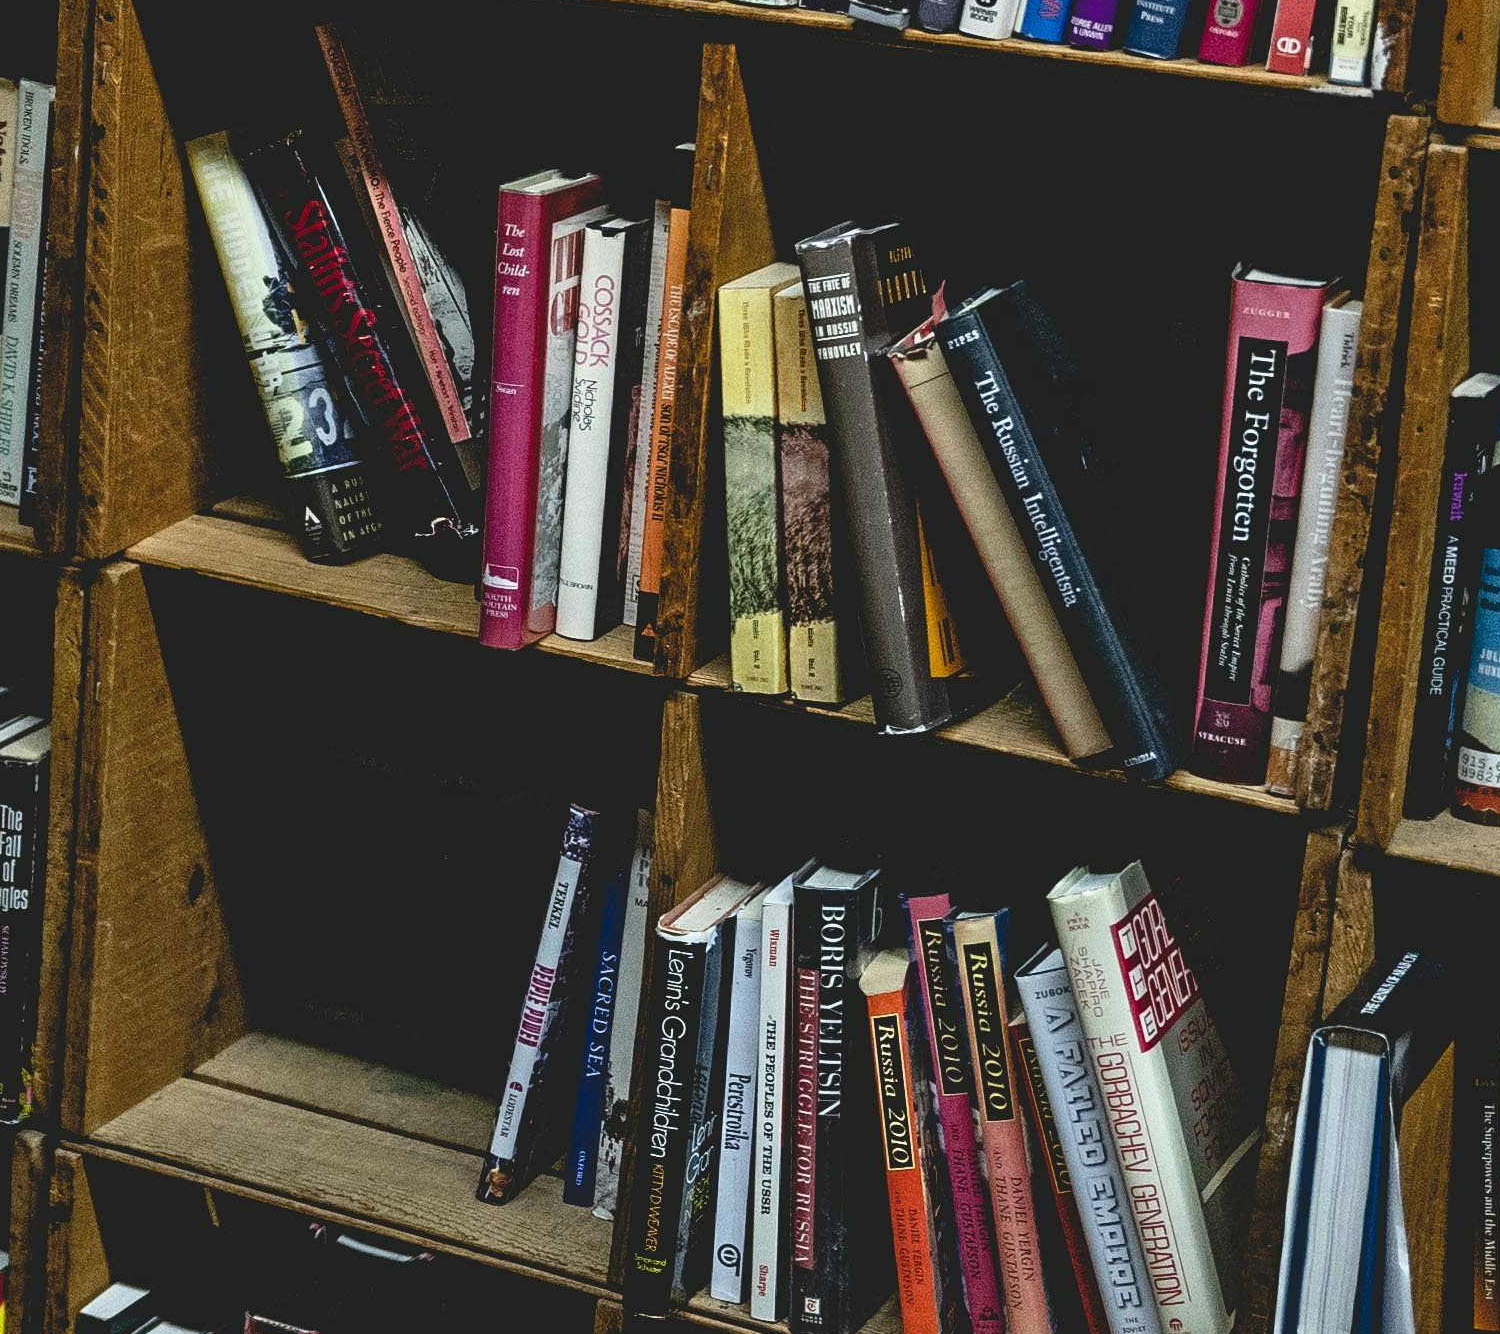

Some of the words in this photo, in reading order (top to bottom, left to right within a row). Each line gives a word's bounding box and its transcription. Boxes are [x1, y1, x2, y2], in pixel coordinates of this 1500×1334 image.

[503, 243, 526, 259] Lost
[504, 224, 526, 239] The
[498, 262, 531, 278] Child-
[502, 285, 522, 297] ren
[590, 273, 617, 368] COSSACK
[1248, 348, 1281, 402] The
[977, 370, 1001, 415] The
[992, 416, 1030, 490] Russian
[1022, 492, 1081, 608] Intelligentsia
[1232, 411, 1271, 541] Forgotten
[0, 804, 23, 832] The
[0, 832, 22, 858] Fall
[2, 861, 15, 882] of
[820, 903, 846, 975] BORIS
[817, 1000, 843, 1117] YELTSIN
[876, 1023, 899, 1093] Russia
[888, 1105, 911, 1164] 2010
